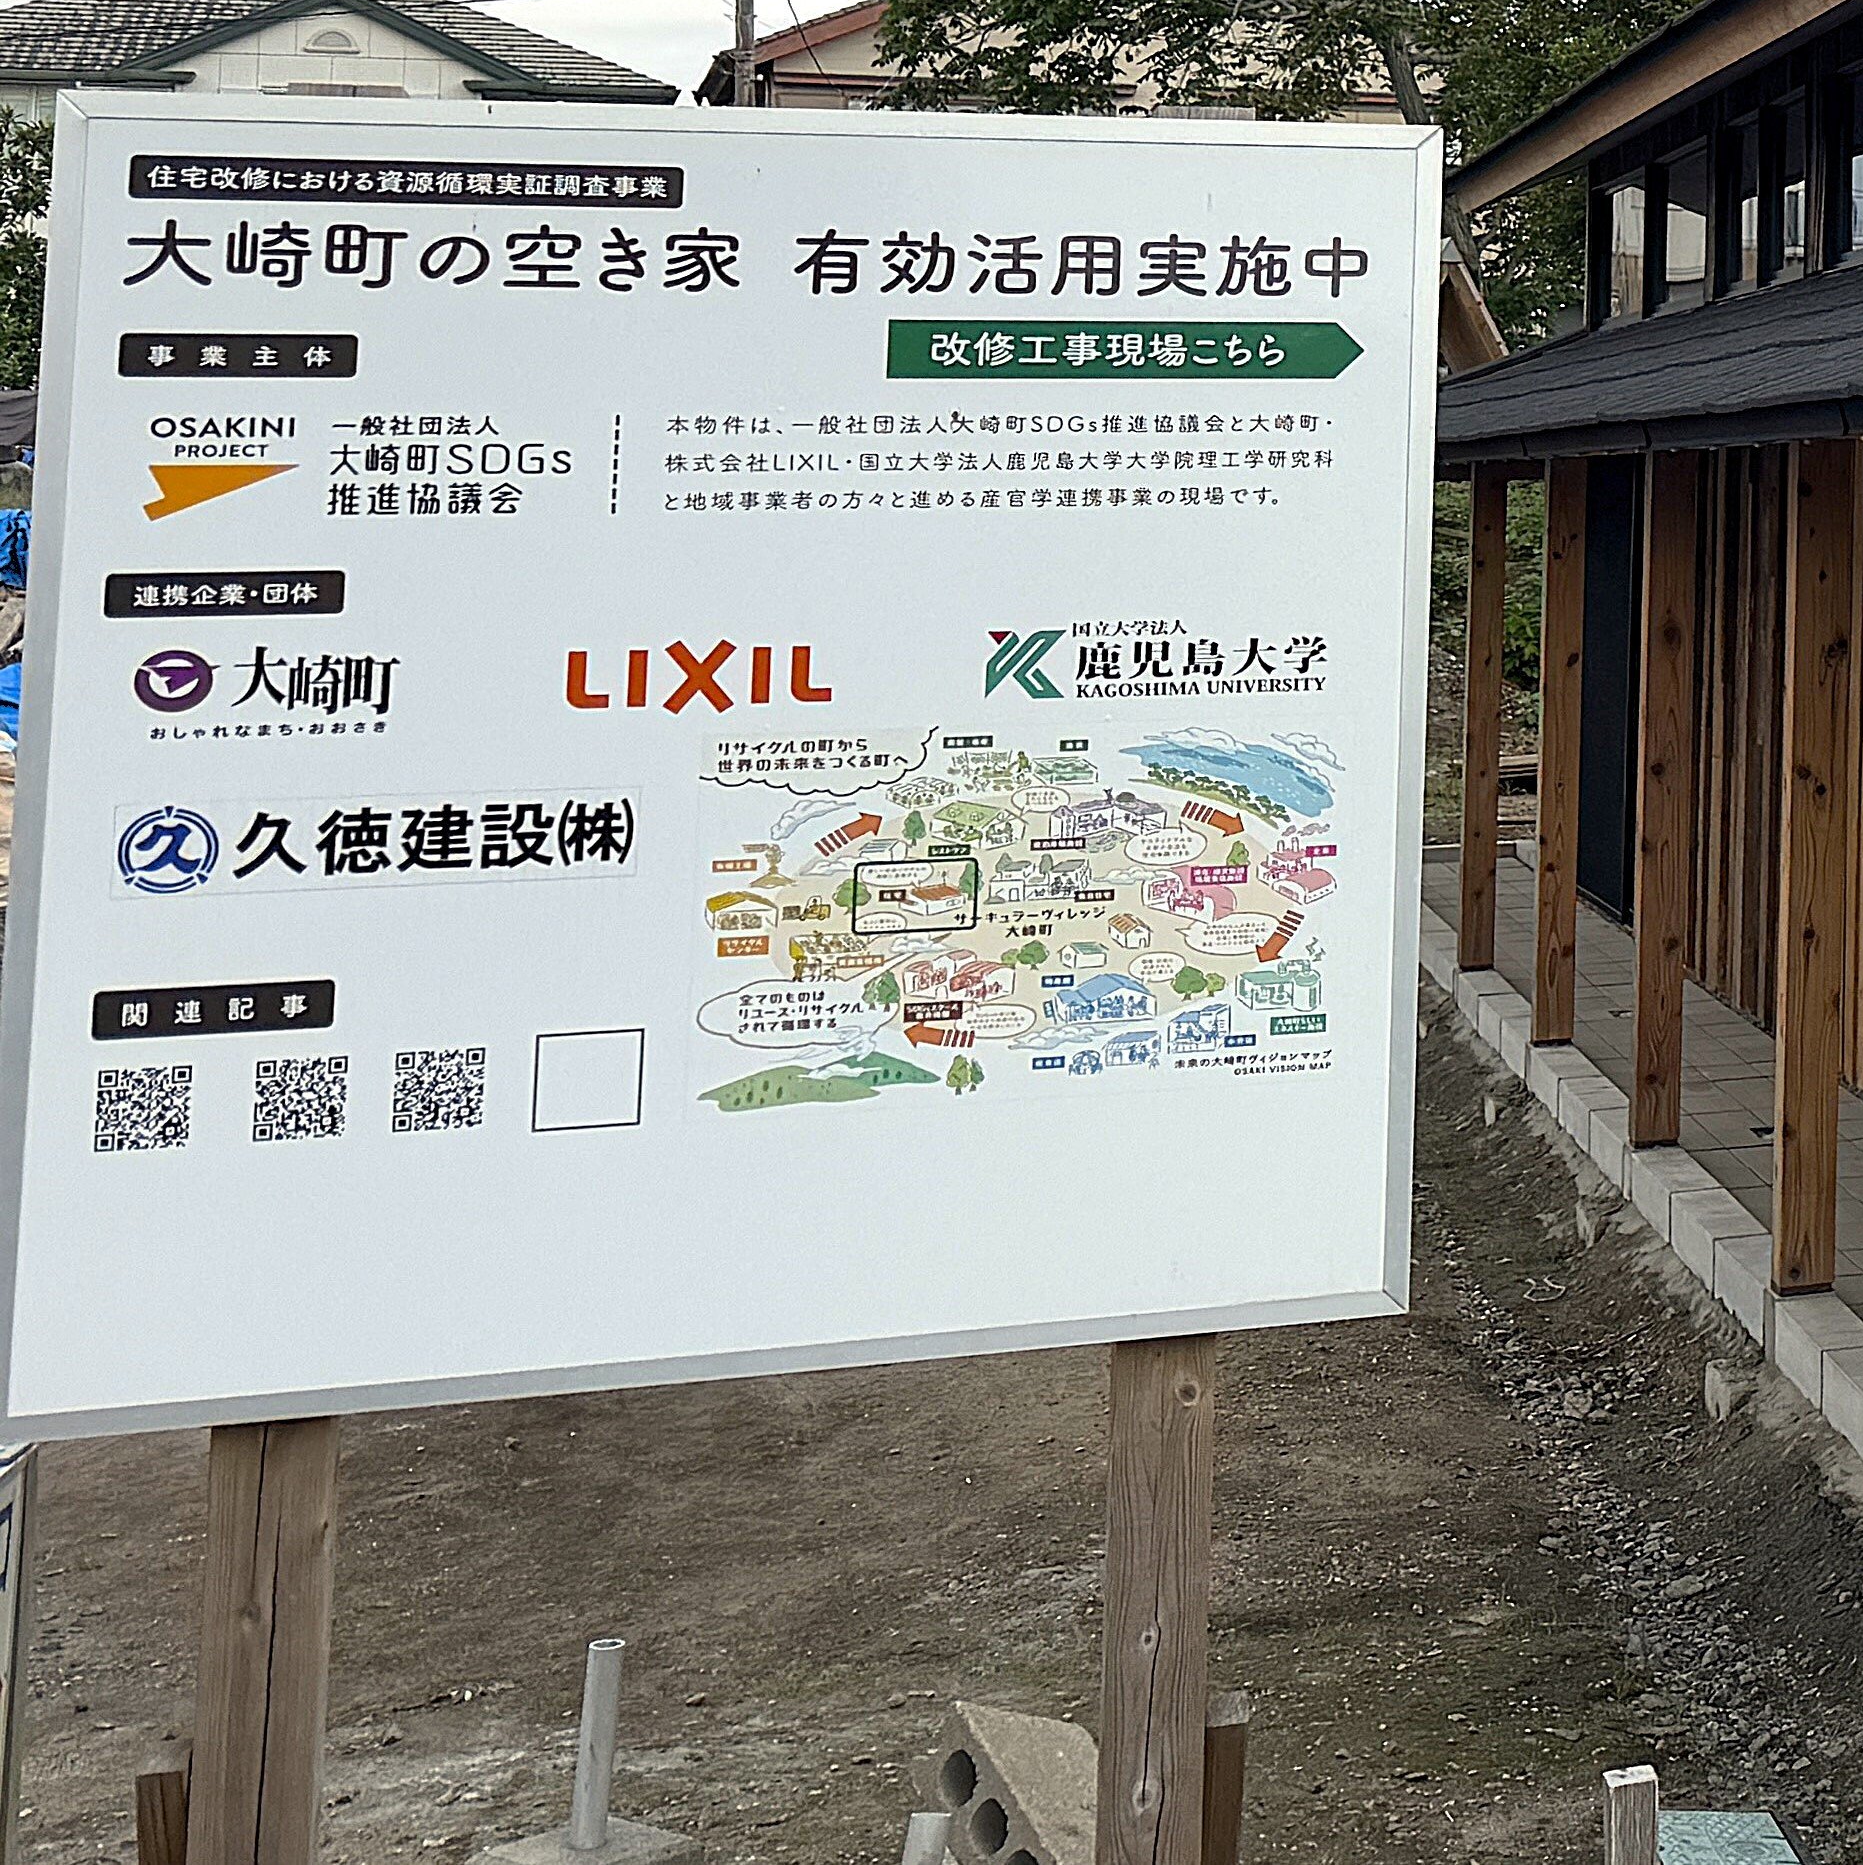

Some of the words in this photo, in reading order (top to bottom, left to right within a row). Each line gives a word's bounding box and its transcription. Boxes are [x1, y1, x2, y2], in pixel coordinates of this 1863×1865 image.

[146, 164, 669, 200] 住宅改修における資源循環実証調査事業
[122, 218, 740, 293] 大崎町の空き家
[793, 228, 1368, 299] 有効活用実施中
[147, 344, 332, 368] 事業主体
[931, 331, 1285, 367] 改修工事現場こちら
[150, 416, 296, 439] OSAKINI
[331, 415, 500, 437] 一般社団法人
[666, 410, 1332, 435] 本物件は、一般社団法人大崎町SDGs推進協議会と大崎町・
[174, 443, 269, 458] PROJECT
[329, 443, 572, 476] 大崎町SDGs
[664, 449, 1333, 473] 株式会社LIXIL・国立大学法人鹿児島大学大学院理工学研究科
[327, 481, 523, 516] 推進協議会
[664, 486, 1278, 512] と地域事業者の方々と進める産官学連携事業の現場です。
[133, 582, 318, 607] 連携企業・団体
[1072, 619, 1187, 638] 国立大学法人
[1075, 636, 1328, 681] 鹿児島大学
[230, 646, 401, 716] 大崎町
[566, 639, 832, 715] LIXIL
[1076, 681, 1201, 699] KAGOSHIMA
[1207, 673, 1326, 695] UNIVERSITY
[150, 721, 386, 740] おしゃれなまち・おおさき
[718, 738, 868, 756] リサイクルの町から
[718, 753, 909, 774] 世界の未来をつくる町へ
[953, 906, 1106, 925] サーキュラーヴィレッジ
[1005, 923, 1053, 938] 大崎町
[120, 993, 309, 1027] 関連記事
[738, 990, 825, 1007] 全てのものは
[738, 1002, 864, 1020] リユース・リサイクル
